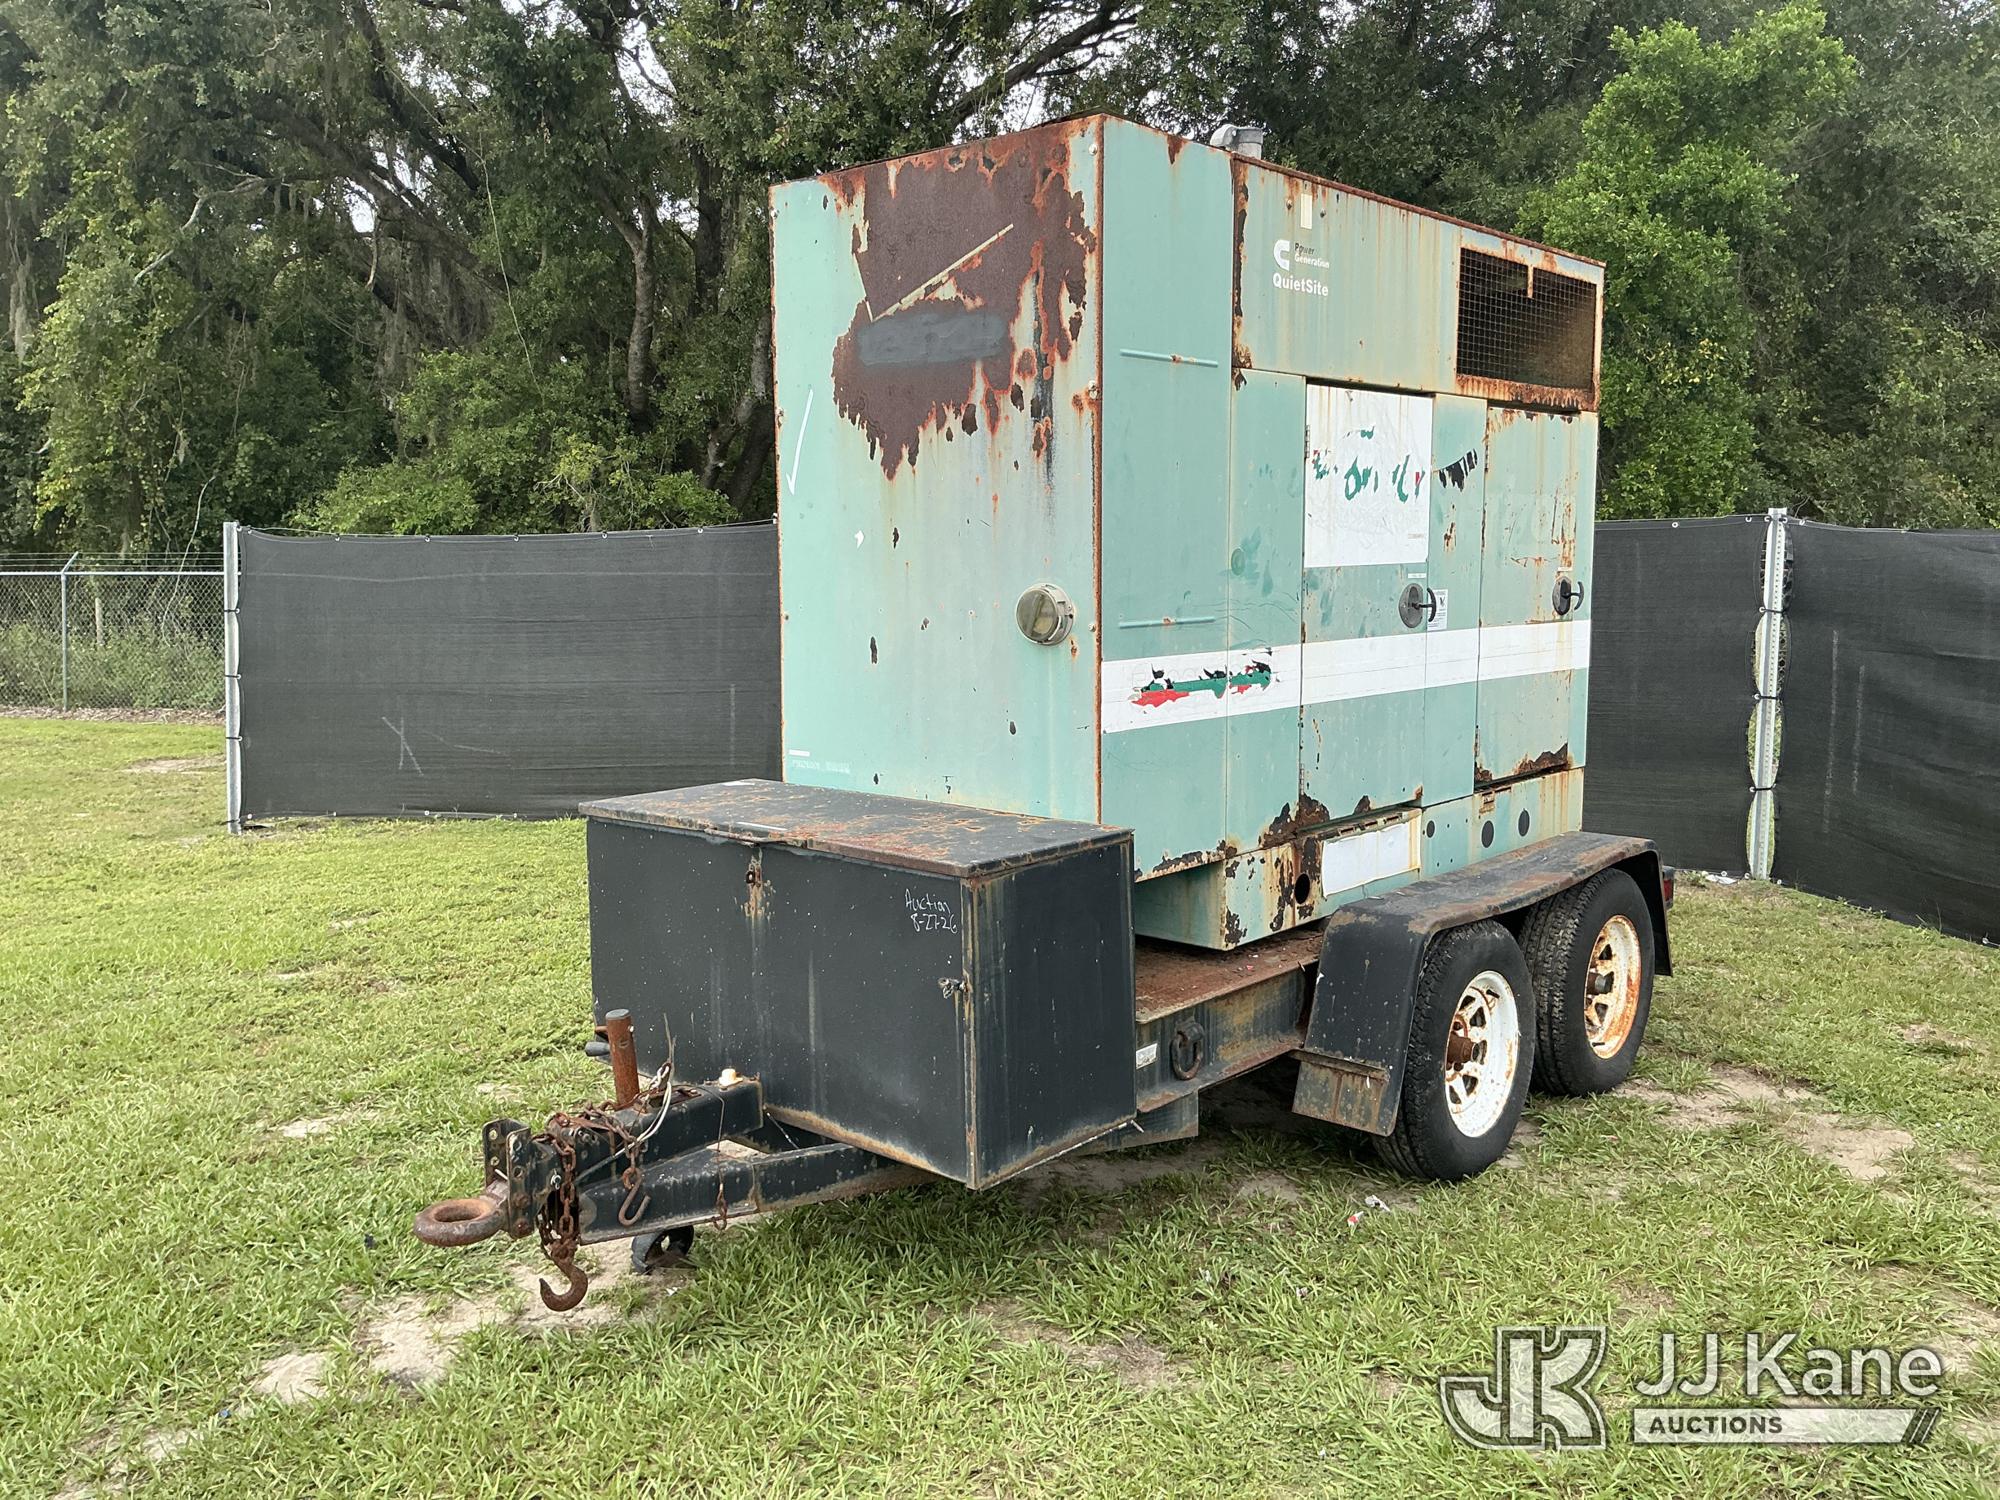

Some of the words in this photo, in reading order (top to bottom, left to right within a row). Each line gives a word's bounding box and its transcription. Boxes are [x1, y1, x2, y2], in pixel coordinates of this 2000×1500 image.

[1294, 242, 1315, 255] Power
[1294, 252, 1330, 269] Generation
[1272, 272, 1329, 297] QuietSite
[905, 888, 950, 914] Auction
